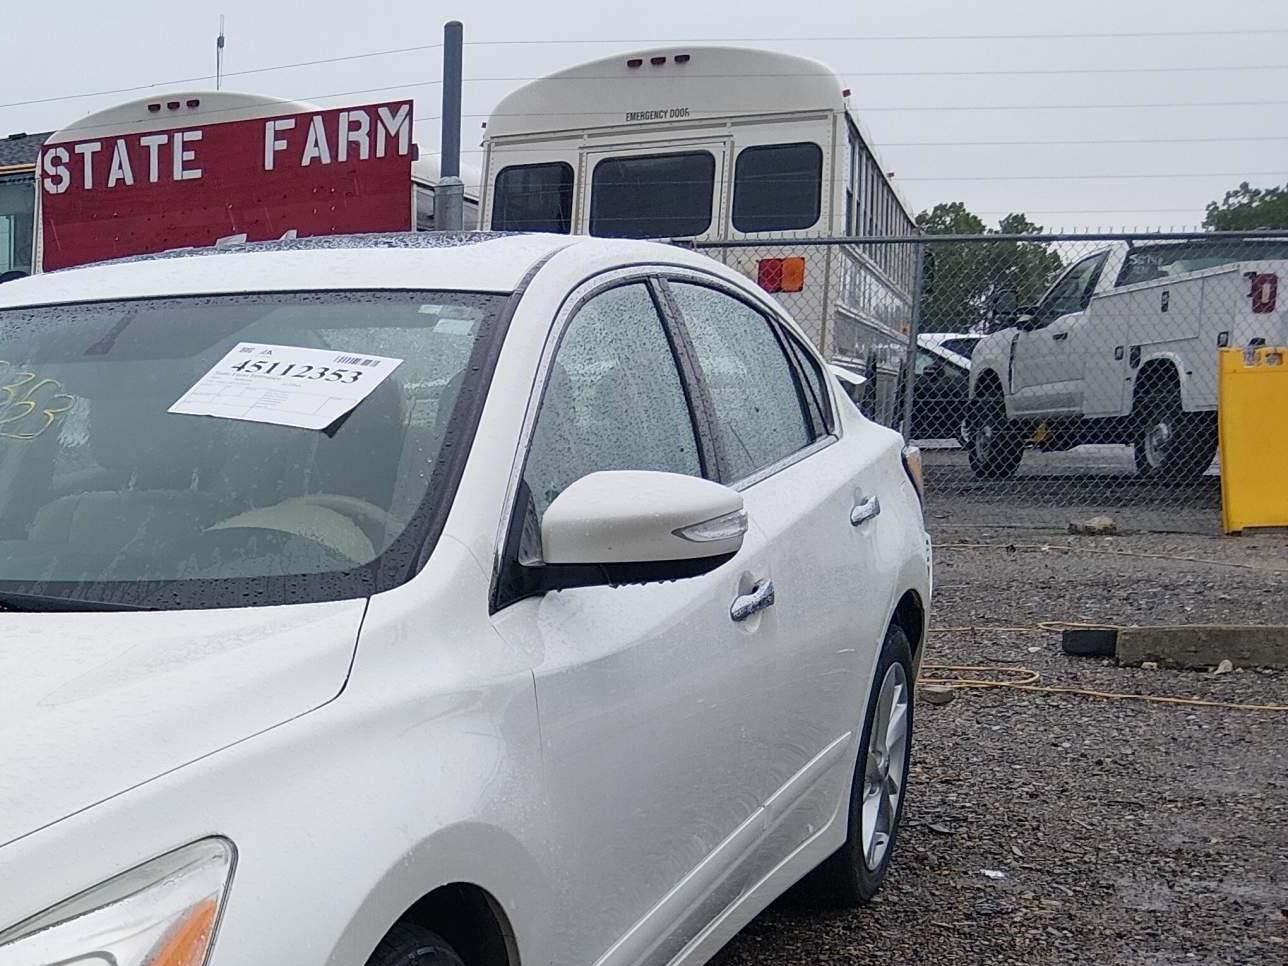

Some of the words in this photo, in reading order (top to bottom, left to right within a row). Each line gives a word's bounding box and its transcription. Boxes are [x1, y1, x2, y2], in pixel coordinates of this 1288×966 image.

[625, 110, 668, 121] EMERGENCY
[669, 108, 690, 118] DOOR
[42, 130, 203, 194] STATE
[263, 103, 411, 171] FARM
[231, 358, 364, 384] 45112353
